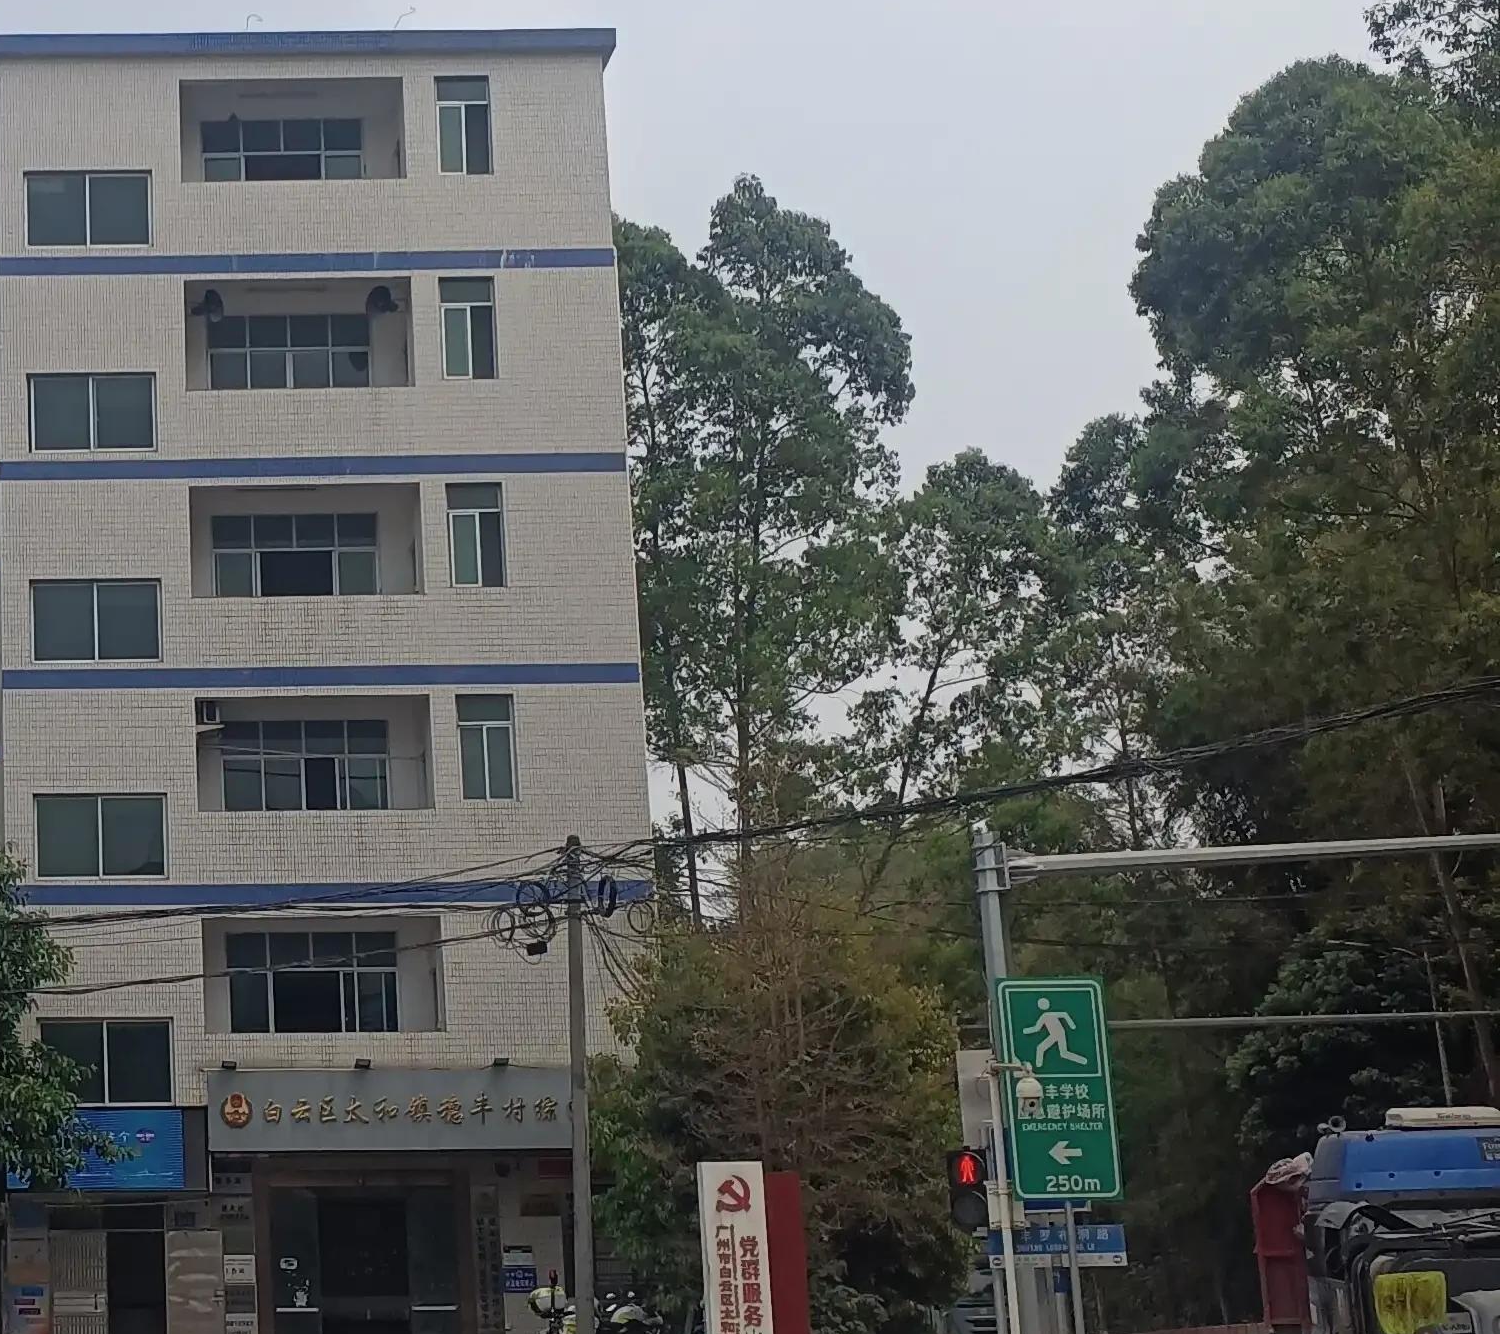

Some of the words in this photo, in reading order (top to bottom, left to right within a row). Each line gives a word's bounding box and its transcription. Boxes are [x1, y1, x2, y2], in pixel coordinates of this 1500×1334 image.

[1043, 1083, 1090, 1100] 丰学校
[260, 1091, 574, 1126] 白云区太和镇穗丰村综
[1018, 1103, 1106, 1120] 避护场所
[1045, 1174, 1101, 1193] 250m
